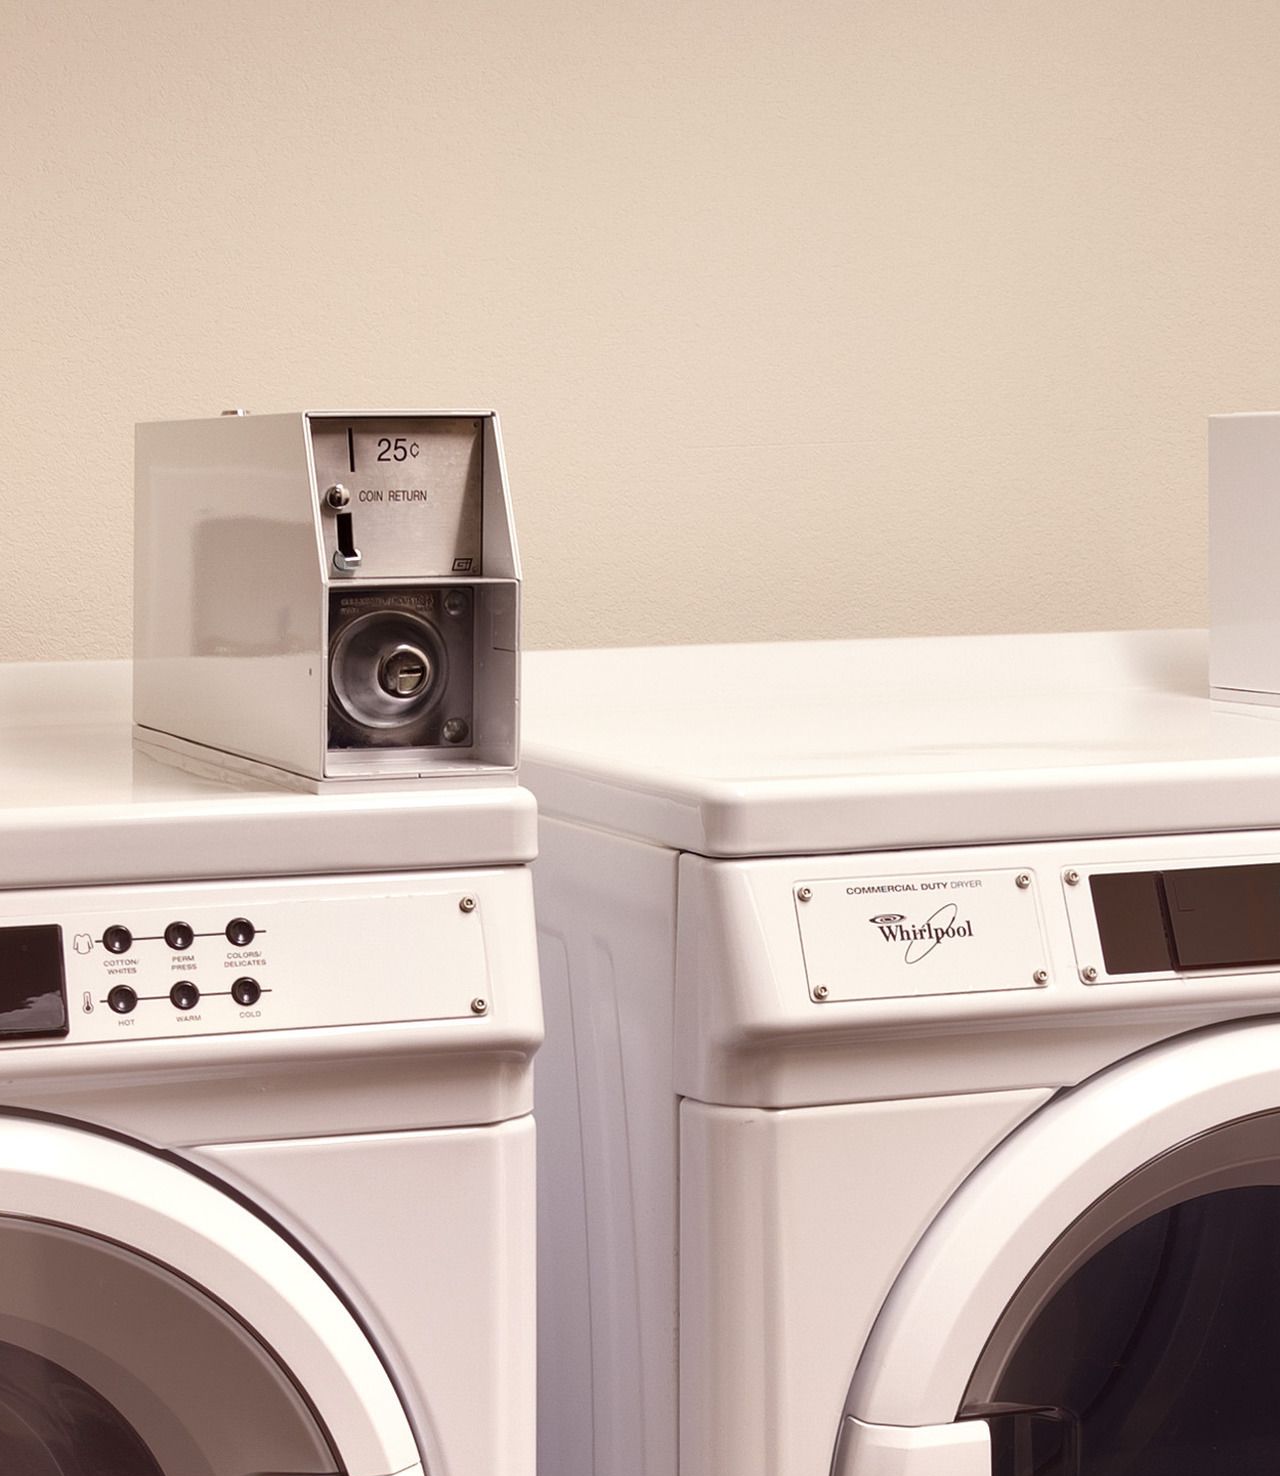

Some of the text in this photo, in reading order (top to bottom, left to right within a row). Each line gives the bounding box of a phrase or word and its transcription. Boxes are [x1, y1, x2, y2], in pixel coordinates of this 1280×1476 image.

[376, 438, 420, 463] 25¢
[359, 489, 427, 502] COIN RETURN
[846, 880, 982, 895] COMMERCIAL DUTY DRYER
[878, 920, 974, 944] Whirlpool
[172, 955, 195, 963] PERM
[171, 963, 197, 972] PRESS
[224, 959, 267, 969] DELICATES
[107, 967, 137, 975] WHITES
[176, 1014, 202, 1023] WARM
[239, 1010, 261, 1019] COLD
[118, 1018, 135, 1027] HOT
